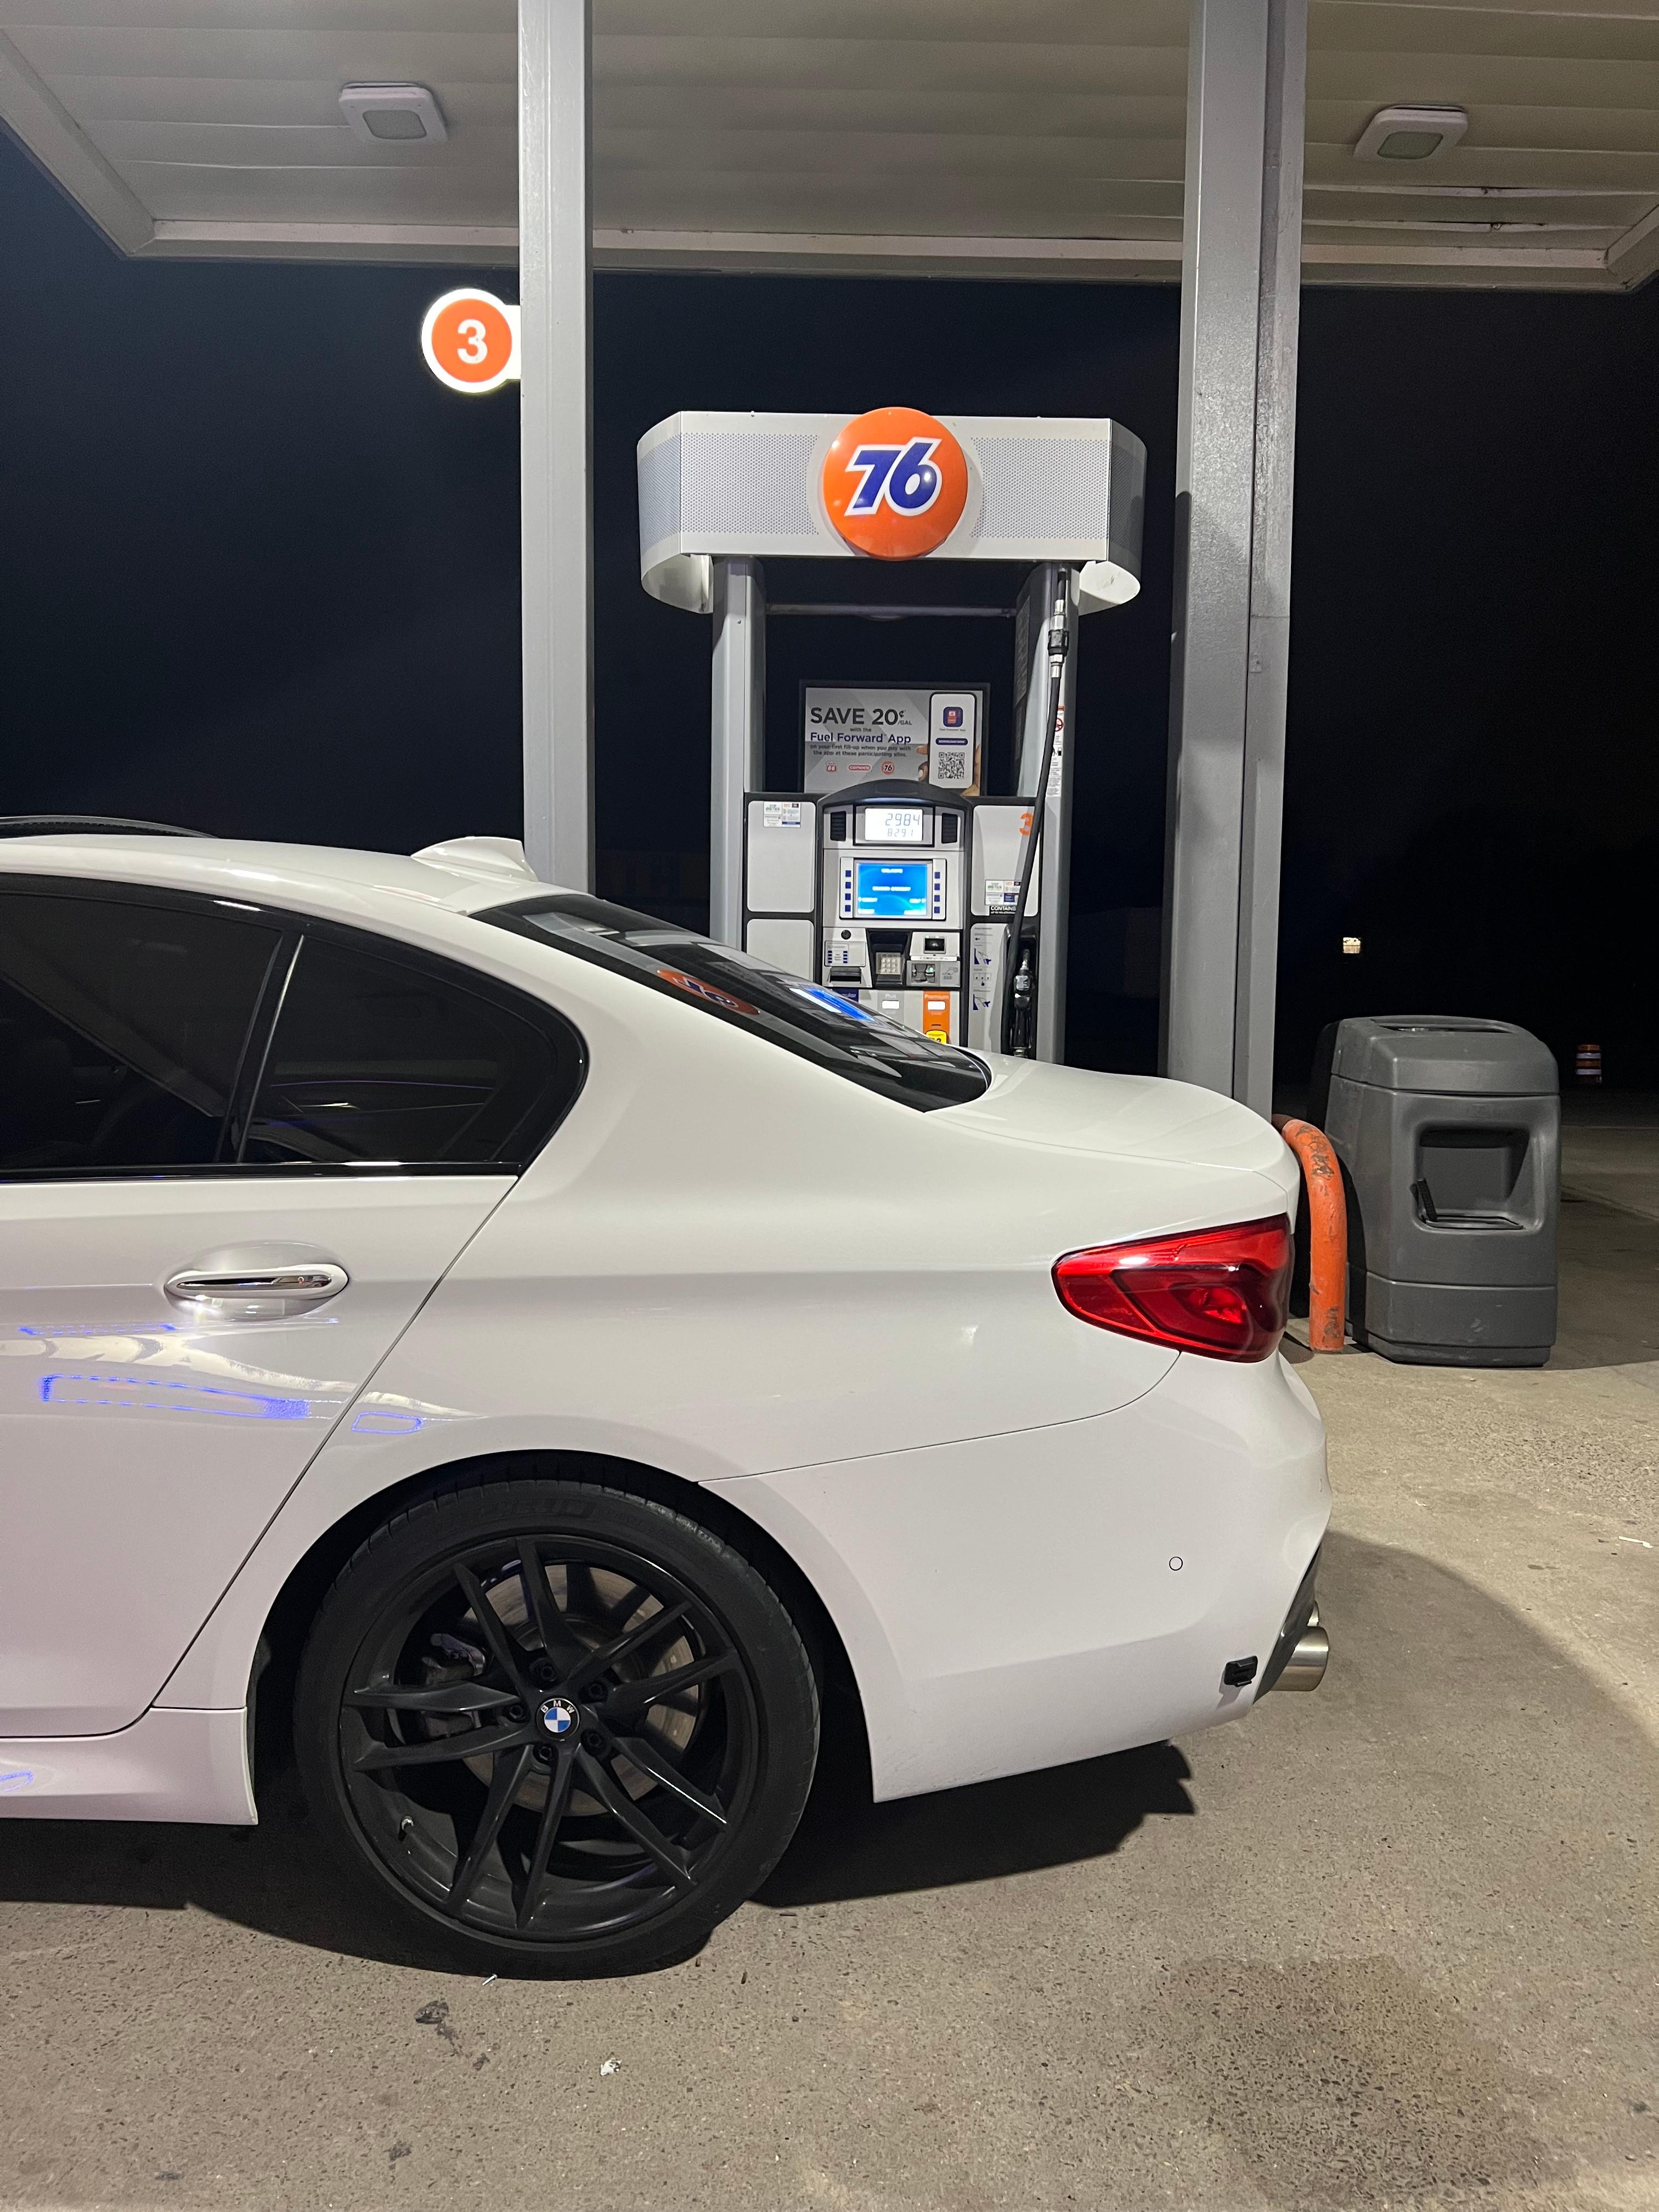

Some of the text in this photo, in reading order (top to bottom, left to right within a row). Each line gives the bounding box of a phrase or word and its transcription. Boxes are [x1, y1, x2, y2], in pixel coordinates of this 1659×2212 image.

[457, 319, 488, 364] 3
[844, 437, 943, 516] 76
[810, 707, 865, 725] SAVE
[810, 732, 911, 745] Fuel Forward App
[1019, 812, 1033, 836] 3
[540, 1700, 575, 1714] BMW
